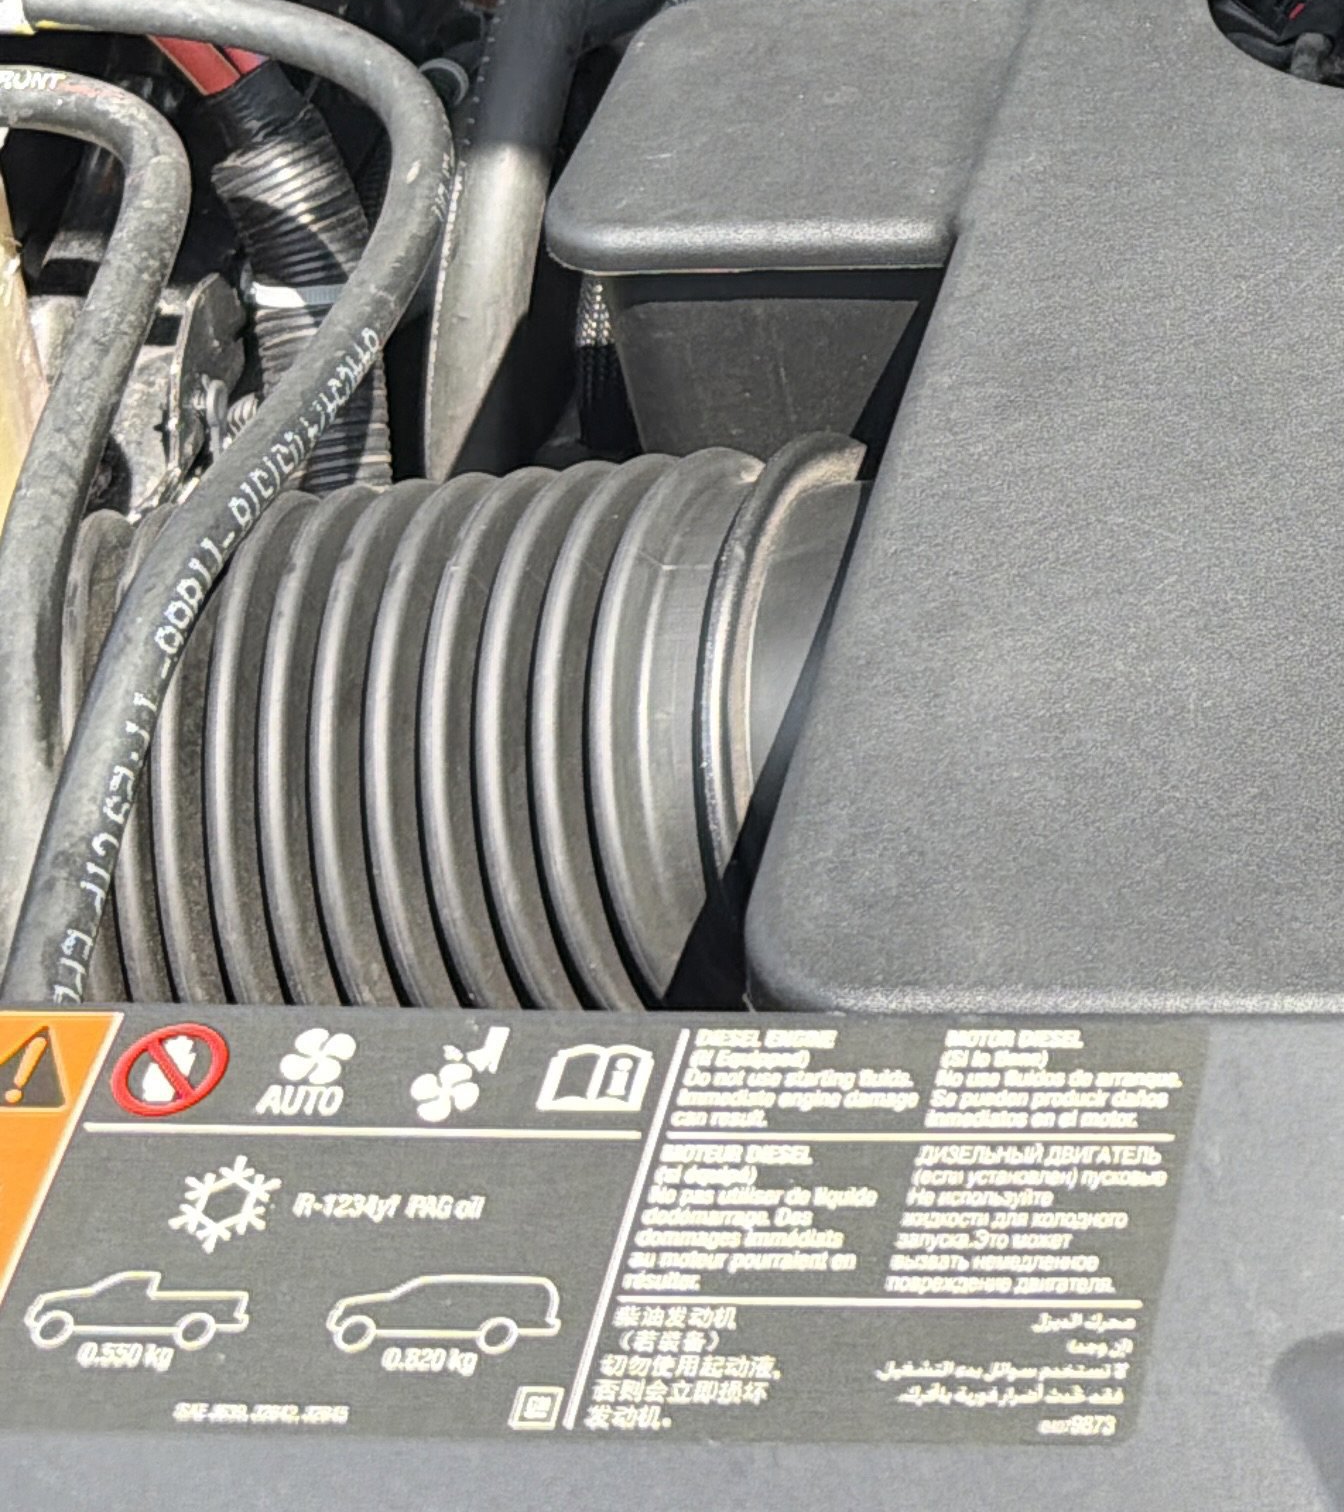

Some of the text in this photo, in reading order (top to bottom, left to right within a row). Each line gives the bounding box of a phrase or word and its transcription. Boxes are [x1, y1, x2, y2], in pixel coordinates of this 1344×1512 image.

[255, 1085, 345, 1117] AUTO
[404, 1194, 455, 1219] PAG
[454, 1196, 485, 1220] oil
[144, 1343, 174, 1372] kg
[381, 1348, 478, 1376] 0.820 kg
